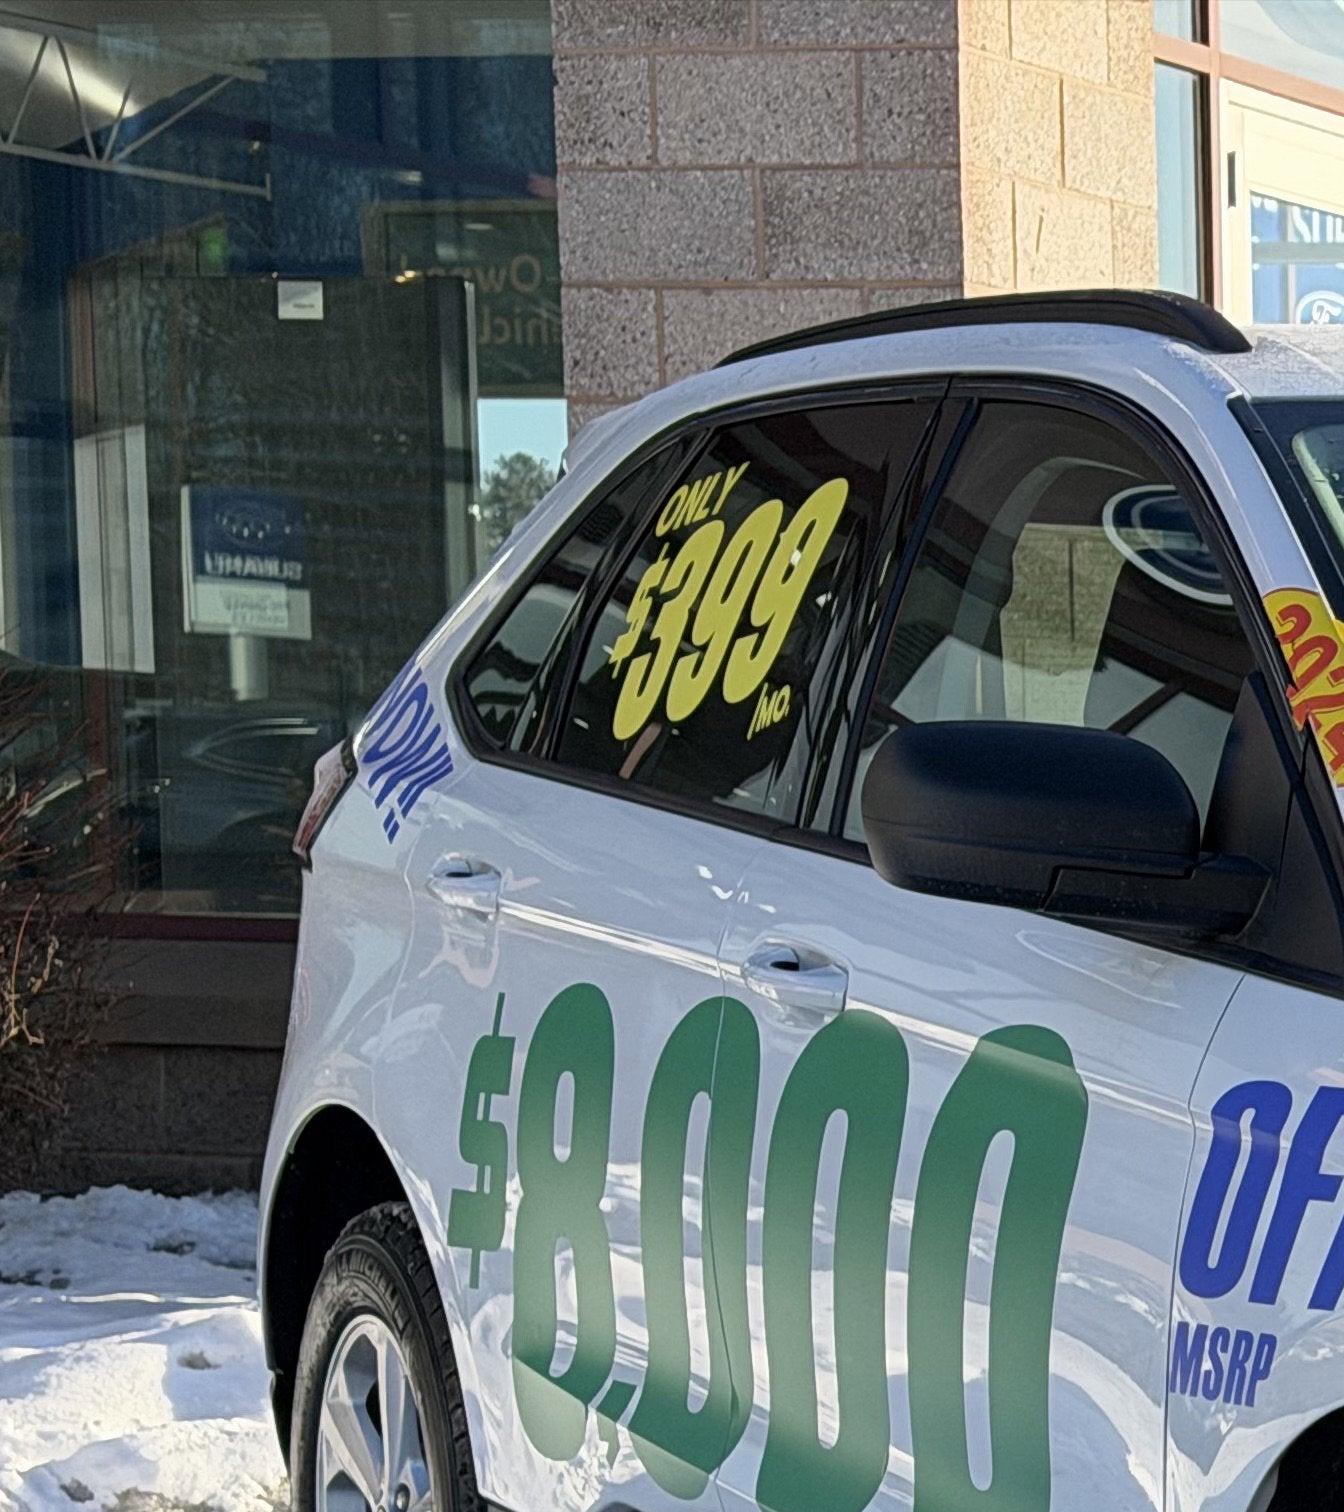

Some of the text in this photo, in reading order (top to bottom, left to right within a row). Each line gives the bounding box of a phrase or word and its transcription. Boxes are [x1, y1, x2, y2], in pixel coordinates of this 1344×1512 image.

[656, 461, 750, 537] ONLY
[609, 477, 848, 740] $399
[1169, 1320, 1278, 1408] MSRP
